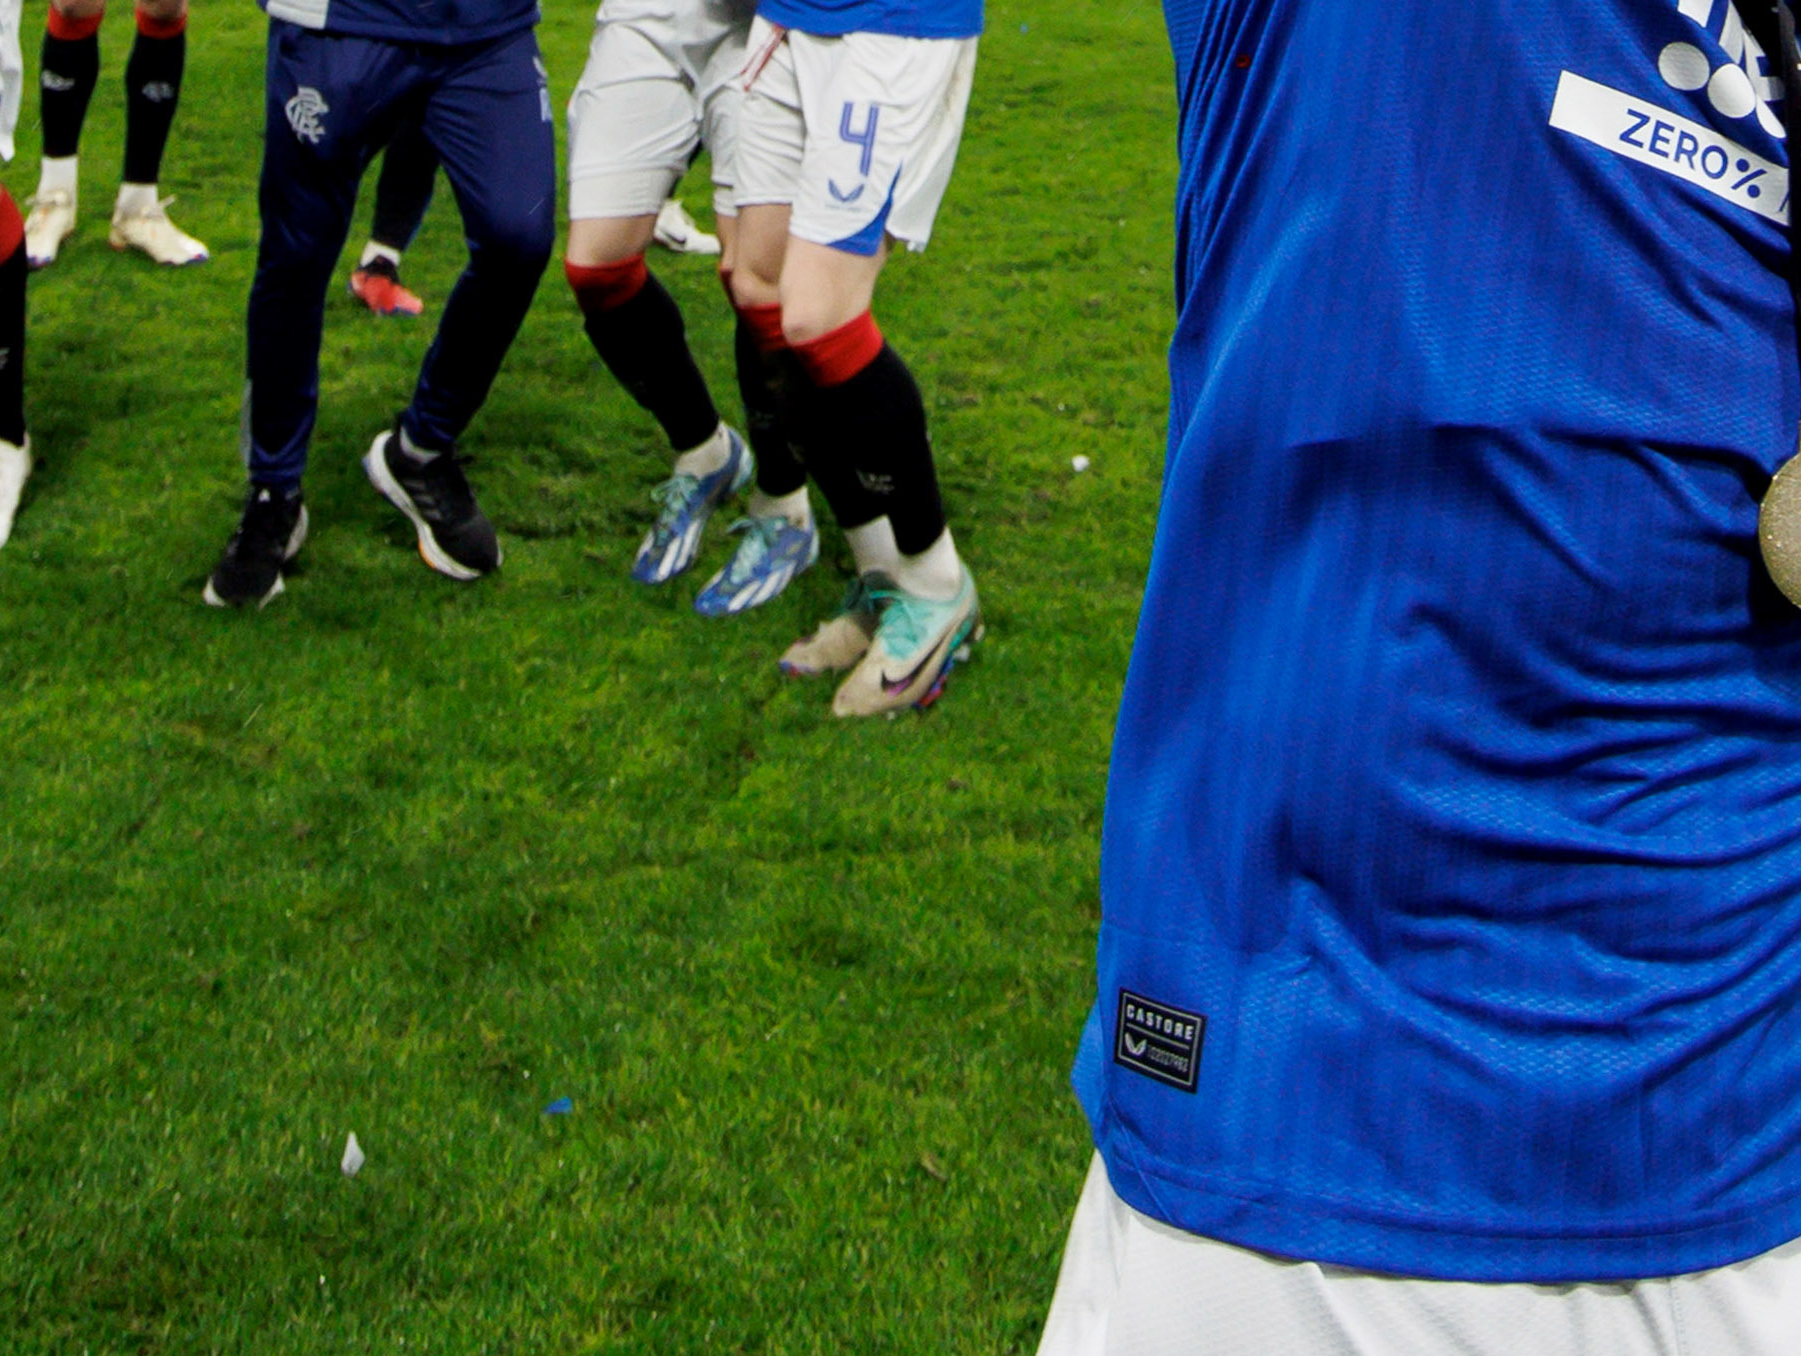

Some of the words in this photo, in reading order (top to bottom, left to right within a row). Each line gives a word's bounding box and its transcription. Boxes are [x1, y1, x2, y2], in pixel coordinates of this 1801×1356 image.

[839, 101, 879, 177] 4
[1618, 108, 1768, 200] ZERO%
[1126, 1003, 1195, 1041] CASTORE
